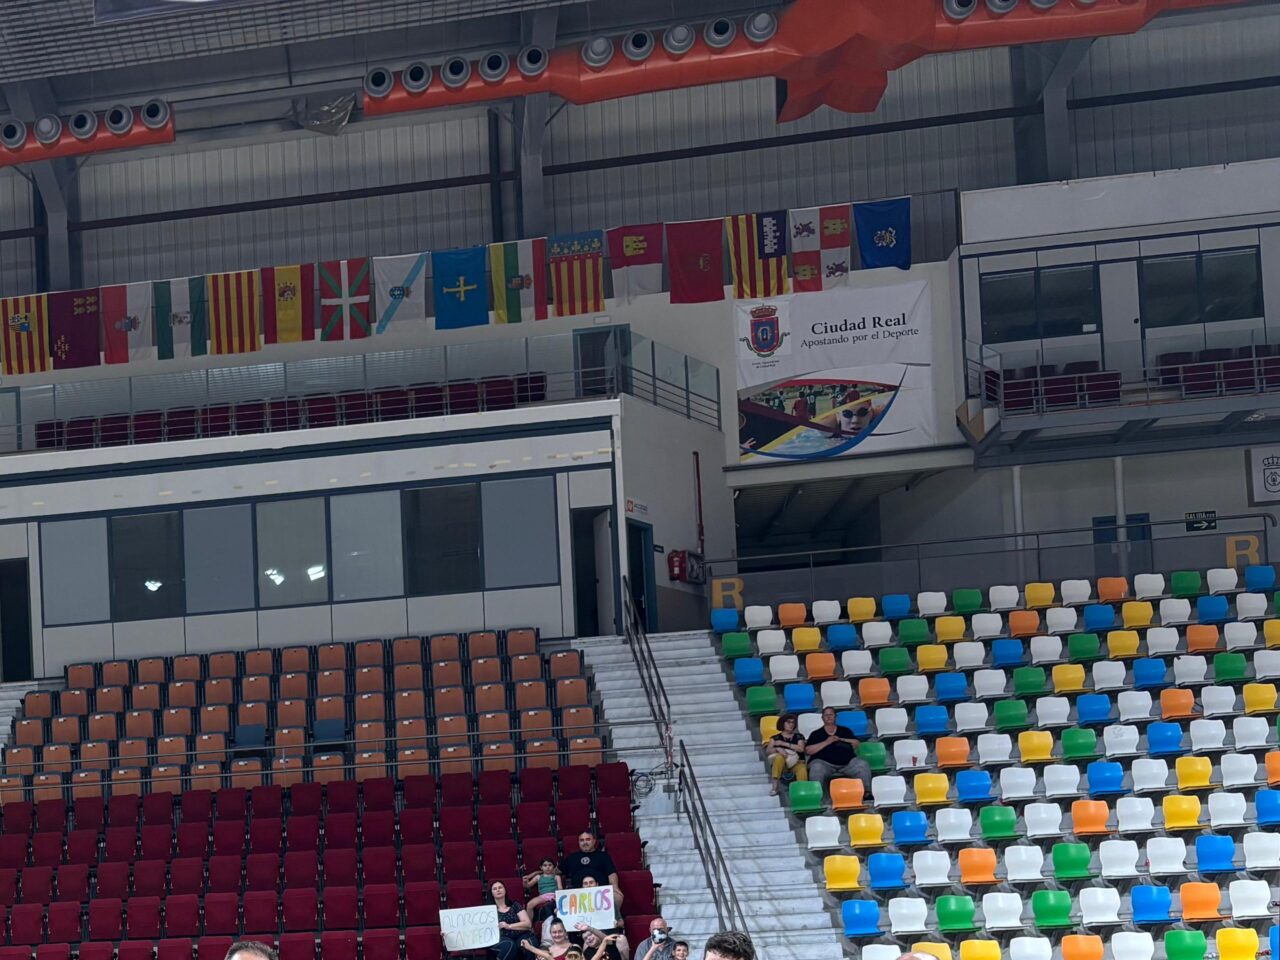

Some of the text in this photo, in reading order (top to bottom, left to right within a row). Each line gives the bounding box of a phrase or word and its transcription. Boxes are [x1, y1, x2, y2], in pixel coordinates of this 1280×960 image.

[811, 313, 907, 335] Ciudad Real
[801, 328, 919, 349] Apostando por el Deporte
[1225, 535, 1261, 569] R
[711, 577, 745, 610] R
[558, 889, 612, 915] CARLOS
